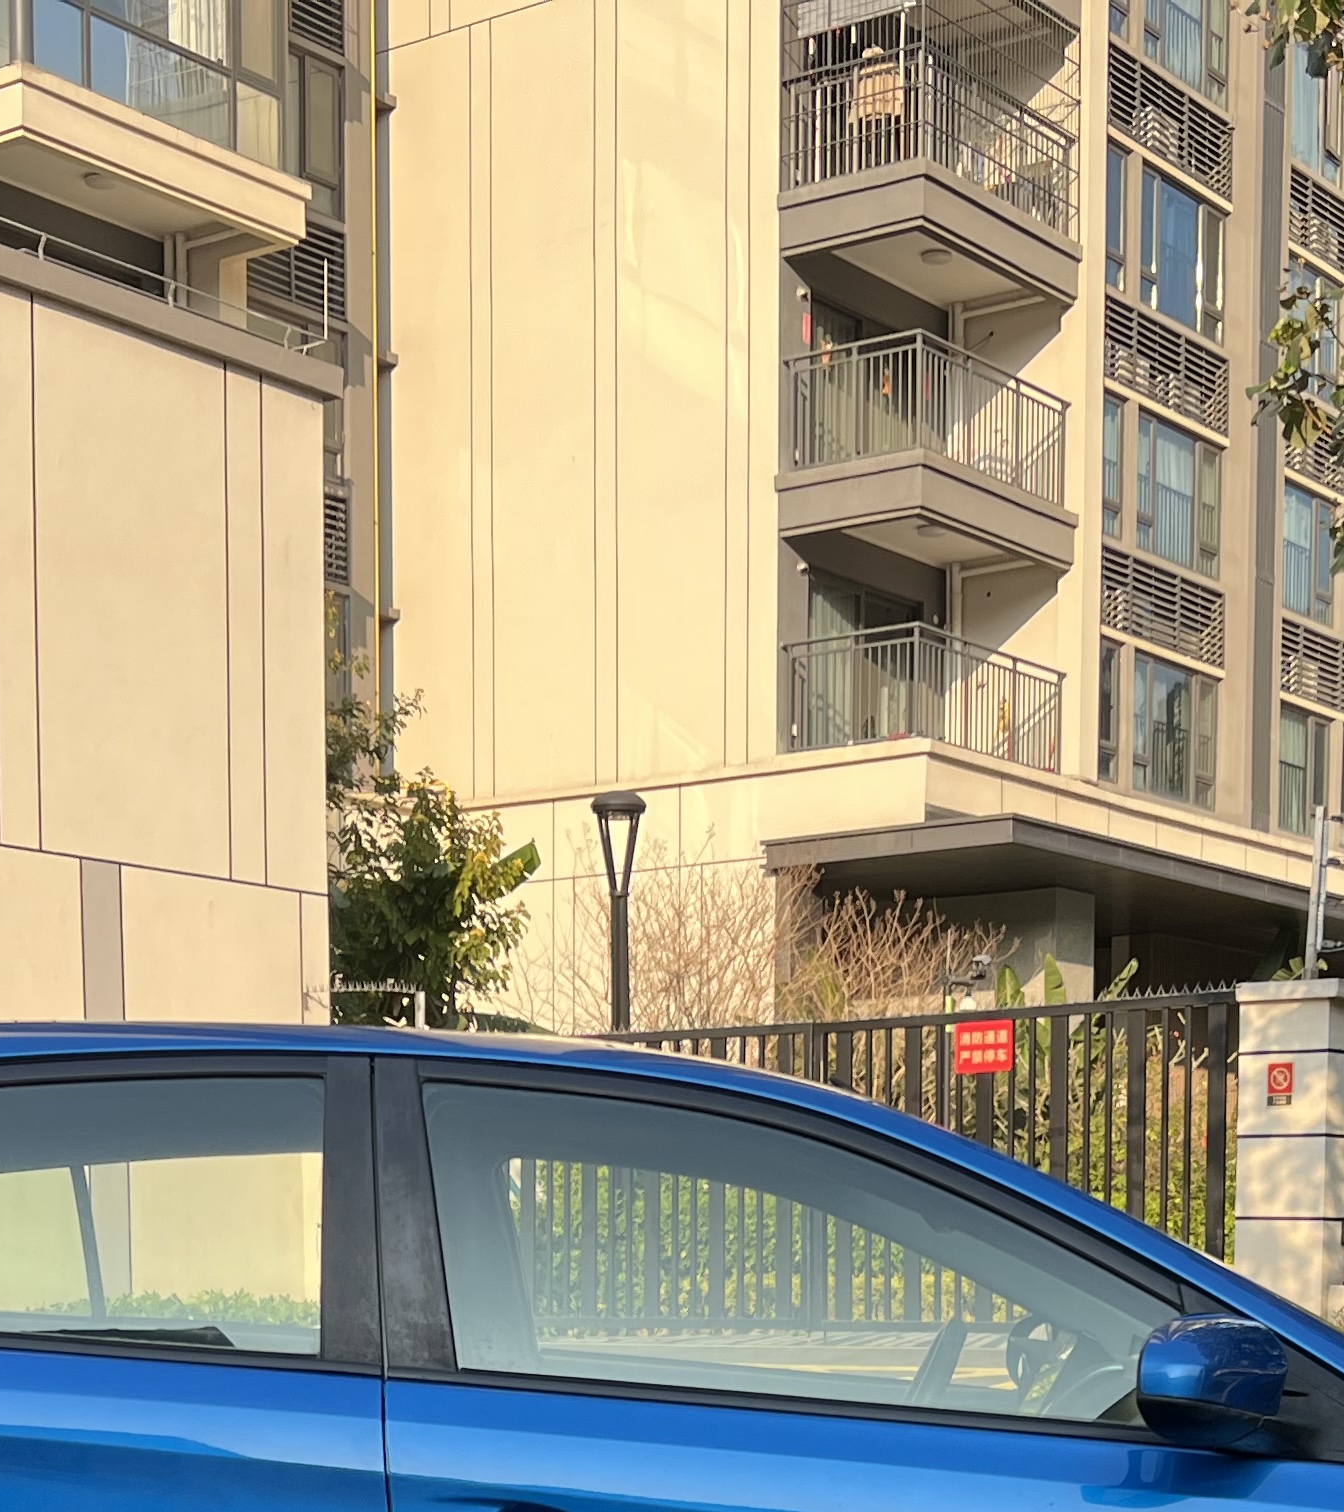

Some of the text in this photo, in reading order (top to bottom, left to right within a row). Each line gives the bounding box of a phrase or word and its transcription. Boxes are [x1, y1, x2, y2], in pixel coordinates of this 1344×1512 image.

[959, 1030, 1007, 1046] 消防通道
[959, 1048, 1007, 1064] 严禁停车
